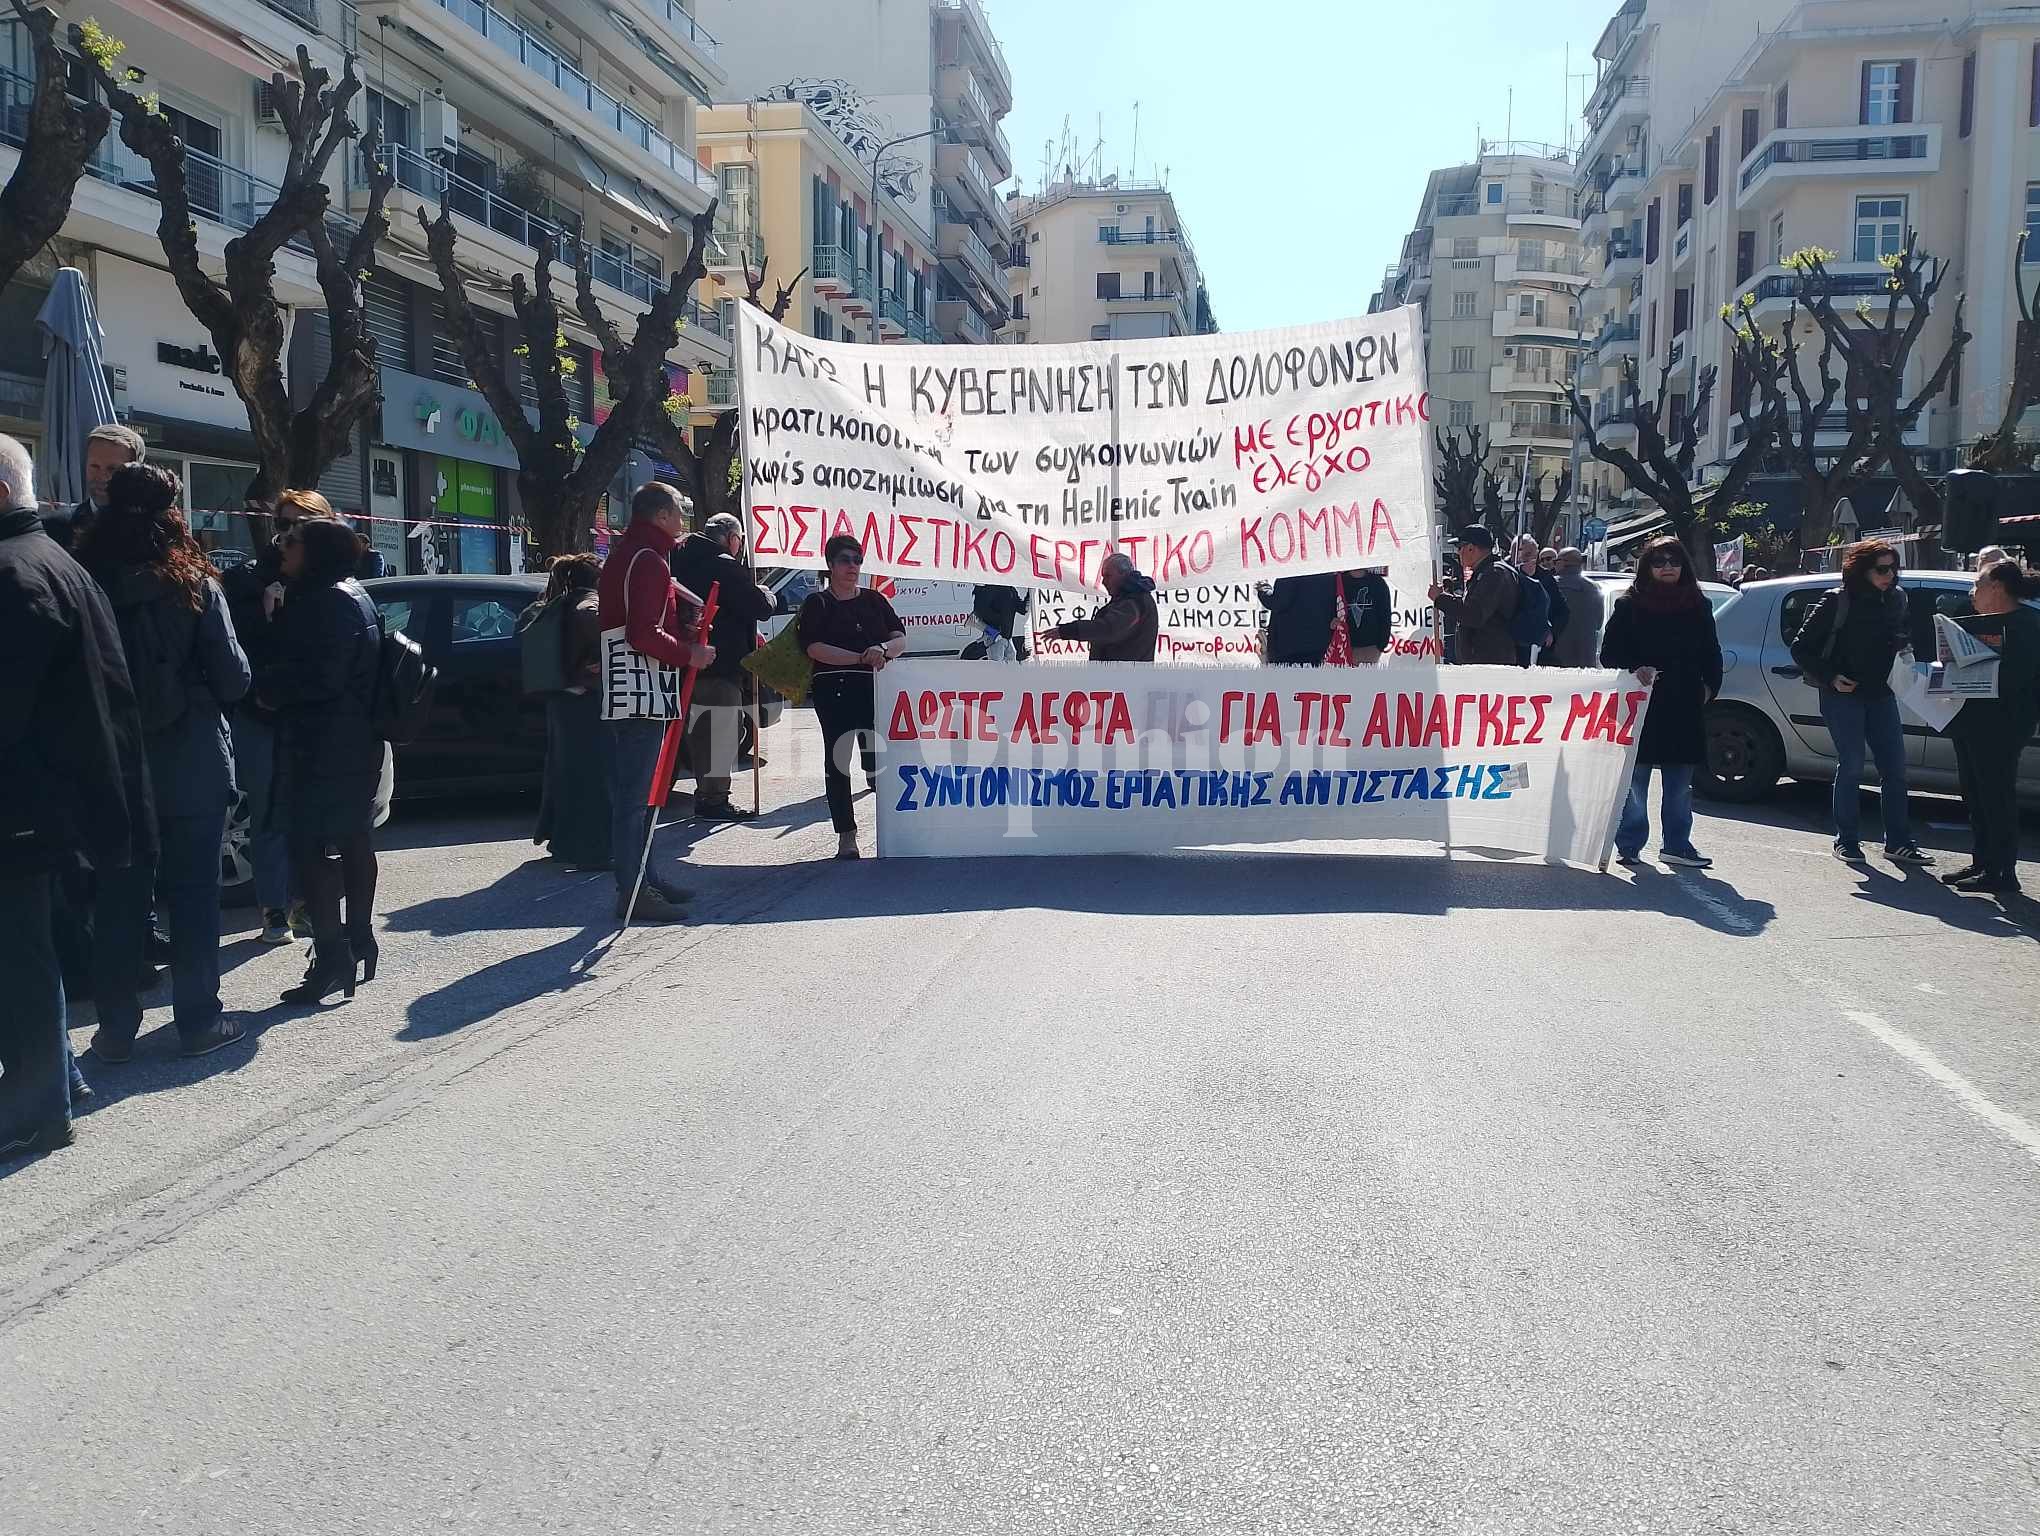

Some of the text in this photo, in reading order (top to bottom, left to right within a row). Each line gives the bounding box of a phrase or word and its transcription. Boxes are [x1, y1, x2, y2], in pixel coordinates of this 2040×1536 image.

[755, 323, 1400, 416] ΚΑΤΩ Η ΚΥΒΕΡΝΗΣΗ ΤΩΝ ΔΟΛΟΦΟΝΩΝ
[964, 449, 1019, 475] των
[1035, 426, 1223, 484] συγκοινωνιών
[1234, 418, 1276, 470] με
[749, 450, 805, 497] χωρίς
[812, 463, 965, 509] αποζημίωση
[1016, 502, 1049, 526] τη
[1062, 484, 1163, 527] Hellenic
[1166, 475, 1238, 515] Train
[751, 497, 1402, 592] ΣΟΣΙΑΛΙΣΤΙΚΟ ΕΡΓΑΤΙΚΟ ΚΟΜΜΑ
[899, 613, 971, 627] ΠΗΤΟΚΑΘΑΡ
[1038, 588, 1064, 605] ΝΑ
[1167, 608, 1272, 629] ΔΗΜΟΣΙΕ
[608, 691, 680, 719] FILM
[887, 689, 1005, 743] ΔΩΣΤΕ
[1009, 691, 1136, 746] ΛΕΦΤΑ
[1218, 691, 1282, 747] ΓΙΑ
[1293, 691, 1352, 747] ΤΙΣ
[1361, 690, 1553, 749] ΑΝΑΓΚΕΣ
[1559, 689, 1649, 746] ΜΑΣ
[894, 763, 1513, 812] ΣΥΝΤΟΝΙΣΜΟΣ ΕΡΓΑΤΙΚΗΣ ΑΝΤΙΣΤΑΣΗΣ
